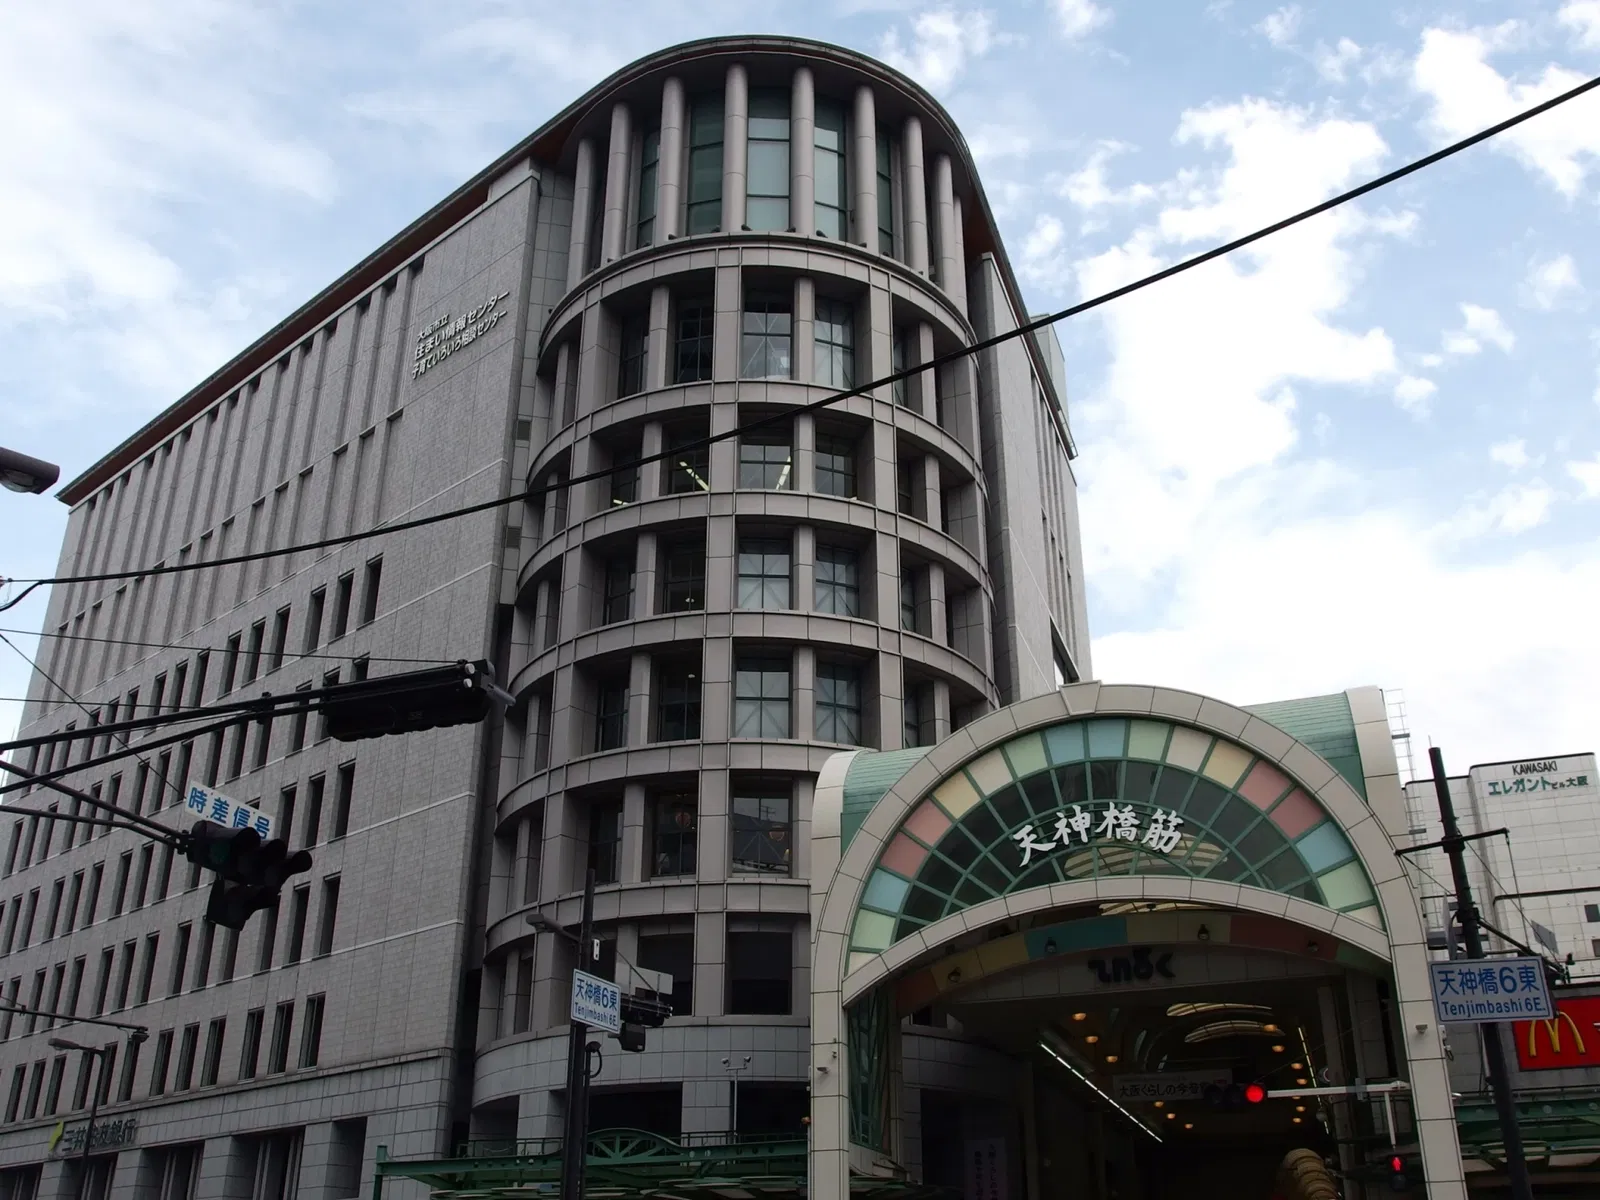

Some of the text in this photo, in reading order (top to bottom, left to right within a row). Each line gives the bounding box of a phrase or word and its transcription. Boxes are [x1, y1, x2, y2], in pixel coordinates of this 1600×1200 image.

[415, 291, 510, 360] 住まい情報センター
[411, 310, 508, 380] 子育ていろいろ相談センター
[1512, 761, 1558, 776] KAWASAKI
[188, 787, 270, 840] 時差信号
[1012, 801, 1185, 868] 天神橋筋
[575, 978, 618, 1012] 天神橋6東
[1437, 965, 1540, 996] 天神橋6東
[574, 1002, 609, 1022] Tenjimbashi
[1441, 998, 1523, 1018] Tenjimbashi
